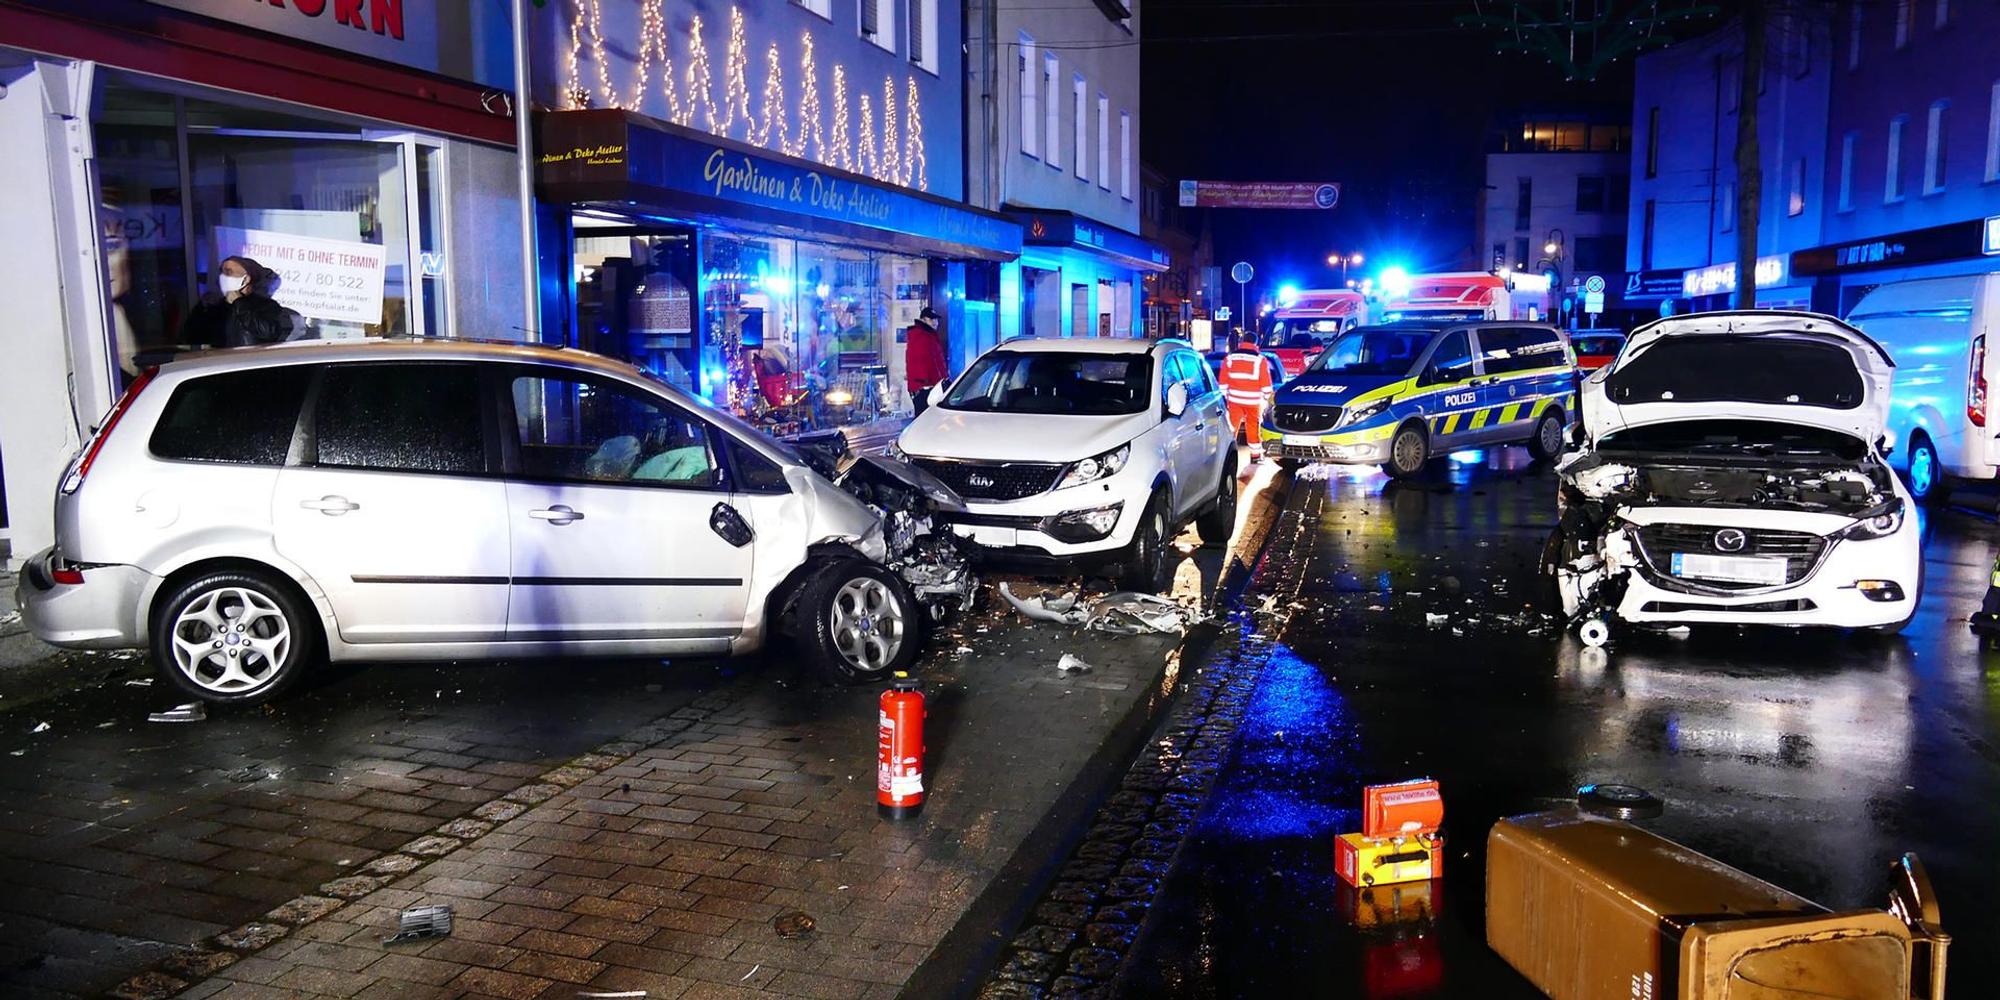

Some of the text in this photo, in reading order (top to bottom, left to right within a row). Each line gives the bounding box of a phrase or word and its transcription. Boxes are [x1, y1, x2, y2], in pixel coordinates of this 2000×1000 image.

[254, 0, 404, 41] RN
[703, 149, 892, 220] Gardinen & Deko Atelier
[276, 246, 294, 260] MIT
[298, 248, 306, 261] &
[308, 249, 335, 265] OHNE
[338, 252, 378, 270] TERMIN!
[315, 272, 333, 287] 80
[338, 274, 364, 290] 522
[1292, 385, 1348, 394] POLIZEI
[1444, 392, 1476, 408] POLIZEI
[969, 476, 989, 487] KIA
[1632, 974, 1641, 997] 120
[1643, 971, 1653, 1000] BIOT
